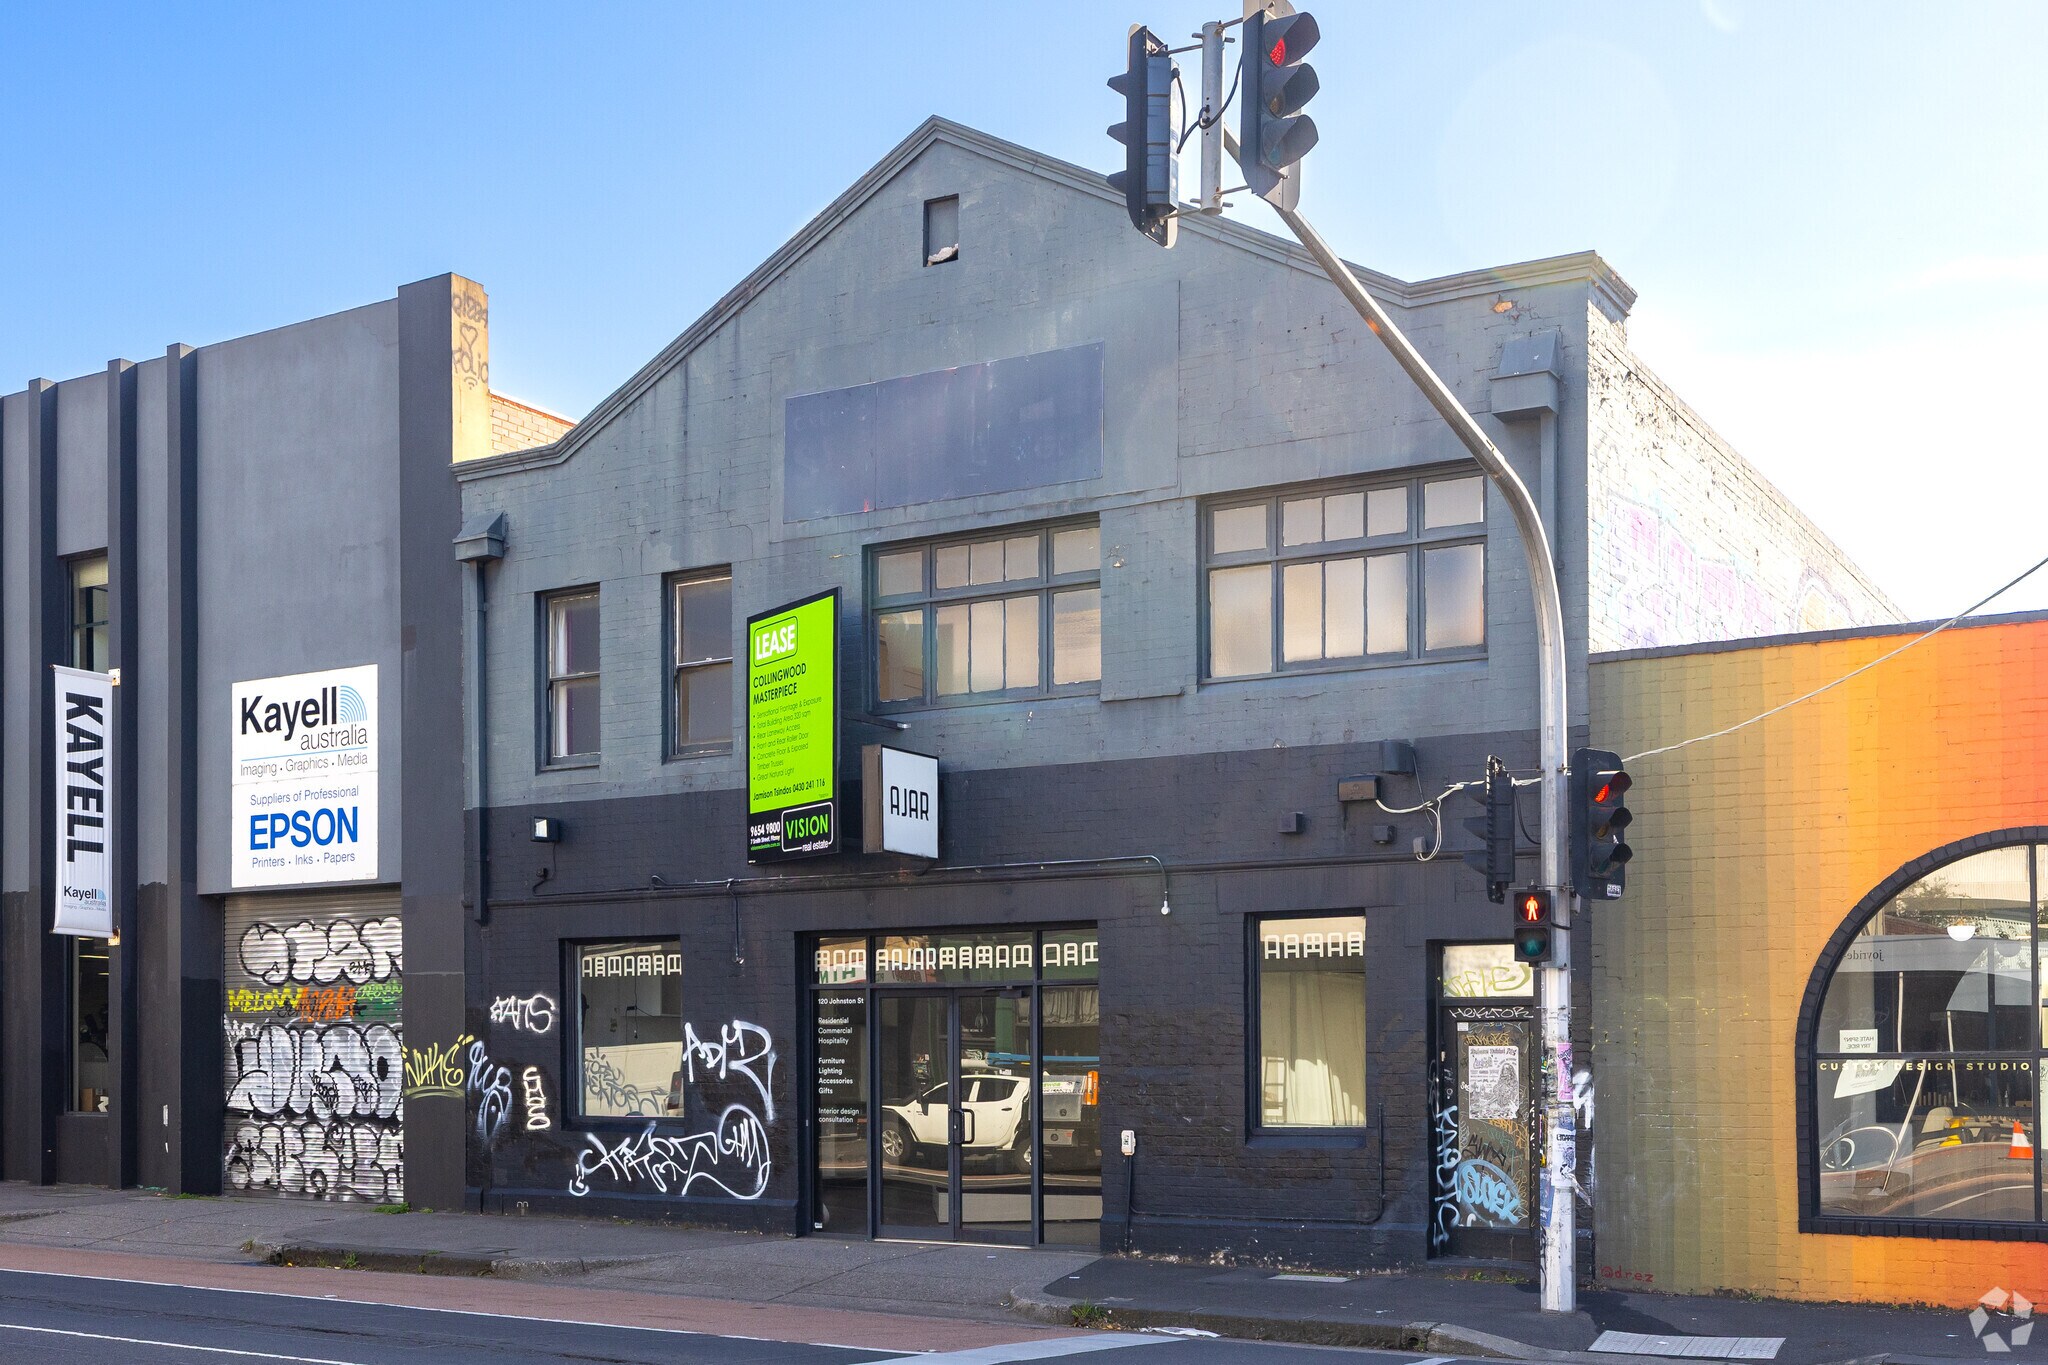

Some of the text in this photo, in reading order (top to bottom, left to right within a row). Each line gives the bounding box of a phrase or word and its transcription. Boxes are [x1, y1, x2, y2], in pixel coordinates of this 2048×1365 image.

[756, 624, 795, 660] LEASE
[753, 663, 807, 688] COLLINGWOOD
[753, 682, 798, 705] MASTERPIECE
[241, 686, 337, 741] Kayell
[301, 724, 368, 750] australia
[66, 692, 104, 862] KAYELL
[240, 753, 368, 778] Imaging Graphics Media
[250, 785, 359, 806] Suppliers of Professional
[753, 778, 825, 801] Jamison Tsindos 0430 241 116
[890, 785, 929, 821] AJAR
[250, 806, 358, 850] EPSON
[750, 821, 780, 837] 9654 9800
[786, 814, 828, 840] VISION
[802, 839, 829, 852] real estate
[252, 851, 355, 868] Printers Inks Papers
[64, 886, 97, 901] Kayell
[818, 1037, 849, 1045] Hospitality
[818, 1067, 843, 1075] Lighting
[1819, 1062, 2030, 1071] CUSTOM DESIGN STUDIO
[840, 1108, 859, 1116] design
[1601, 1265, 1654, 1282] @drez
